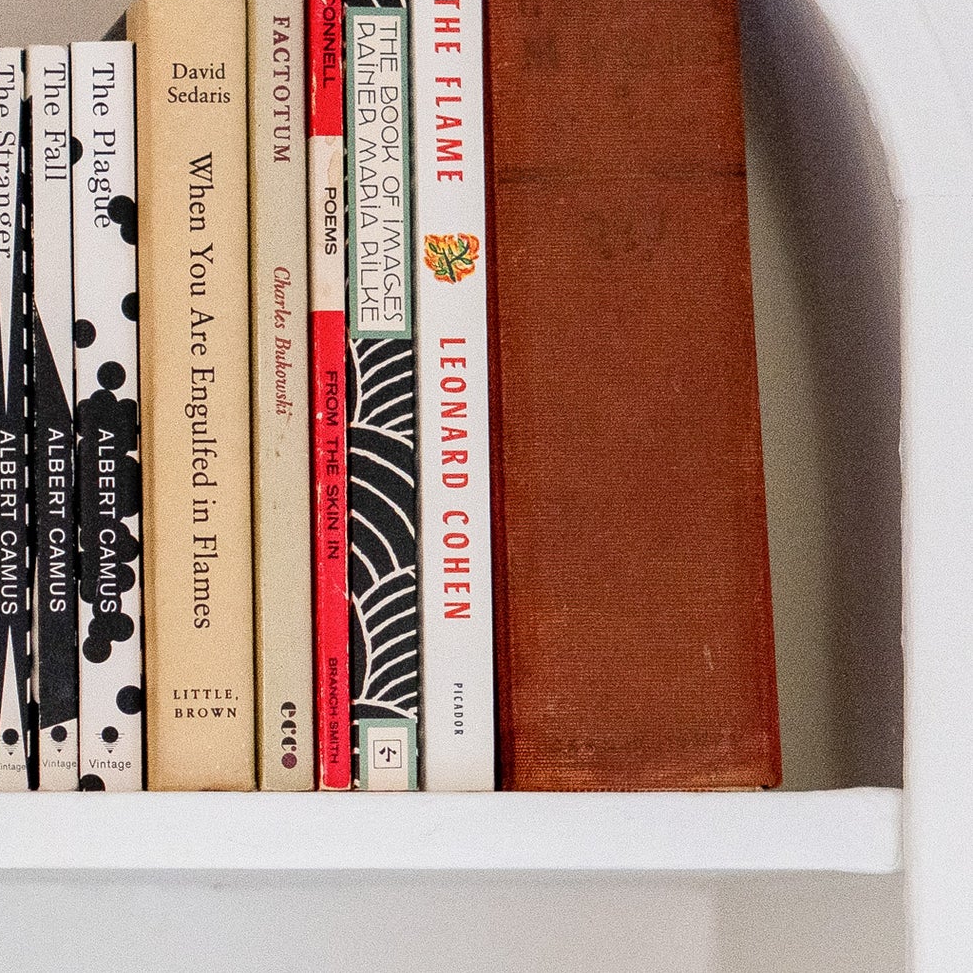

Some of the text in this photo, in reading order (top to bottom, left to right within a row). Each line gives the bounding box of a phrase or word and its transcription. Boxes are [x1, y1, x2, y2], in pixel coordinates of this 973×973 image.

[172, 63, 225, 80] David
[358, 23, 376, 125] RAINER
[380, 22, 397, 72] THE
[44, 63, 67, 181] The Fall
[167, 87, 231, 103] Sedaris
[273, 16, 292, 163] FACTOTUM
[381, 87, 399, 161] BOOK
[87, 63, 116, 228] The Plague
[435, 77, 463, 182] FLAME
[325, 187, 337, 255] POEMS
[382, 176, 400, 207] OF
[360, 243, 379, 322] RILKE
[274, 266, 293, 415] Charles Bukowski
[185, 152, 219, 629] When You Are Engulfed in Flames
[326, 371, 338, 560] FROM THE SKIN IN
[440, 337, 471, 619] LEONARD COHEN
[0, 430, 18, 615] ALBERT CAMUS
[48, 428, 66, 613] ALBERT CAMUS
[98, 429, 116, 613] ALBERT CAMUS
[174, 690, 240, 701] LITTLE,
[174, 707, 237, 718] BROWN
[453, 683, 463, 736] PICADOR
[42, 759, 77, 771] Vintage
[89, 759, 131, 771] Vintage
[280, 701, 297, 770] ecco
